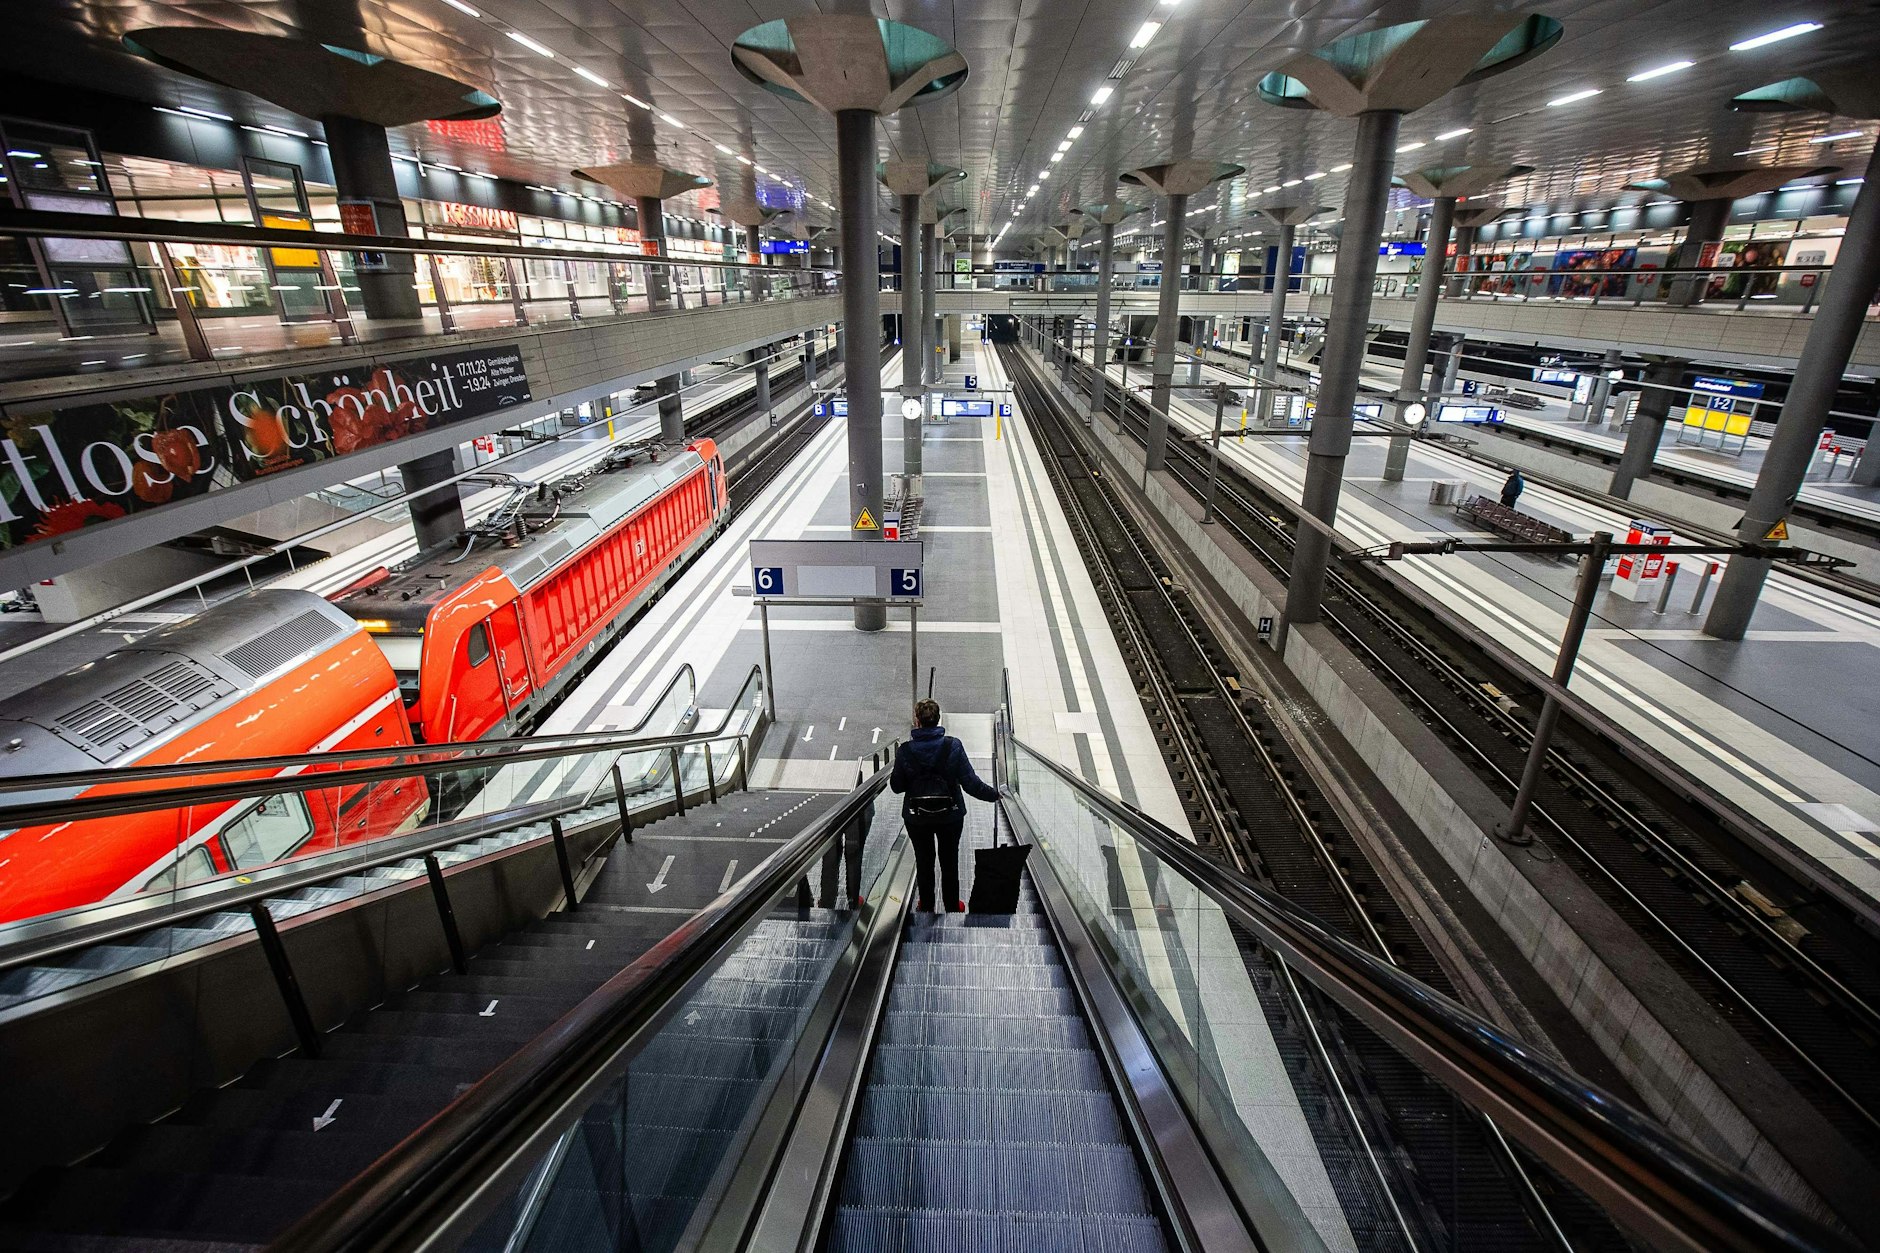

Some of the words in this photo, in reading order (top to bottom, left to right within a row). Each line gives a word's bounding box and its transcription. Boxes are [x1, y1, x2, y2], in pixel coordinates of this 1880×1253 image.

[440, 201, 517, 229] ROSSMANN
[456, 359, 486, 377] 17.11.23
[499, 366, 515, 375] Meister
[509, 373, 526, 383] Dresden
[969, 376, 976, 386] 5
[1468, 381, 1476, 391] 3
[1713, 396, 1731, 410] 1-2
[815, 405, 823, 415] B
[1003, 405, 1011, 415] B
[1496, 411, 1505, 421] B
[0, 424, 215, 523] tlose
[228, 363, 463, 461] Schönheit
[758, 568, 773, 590] 6
[902, 569, 917, 591] 5
[1260, 618, 1271, 632] H
